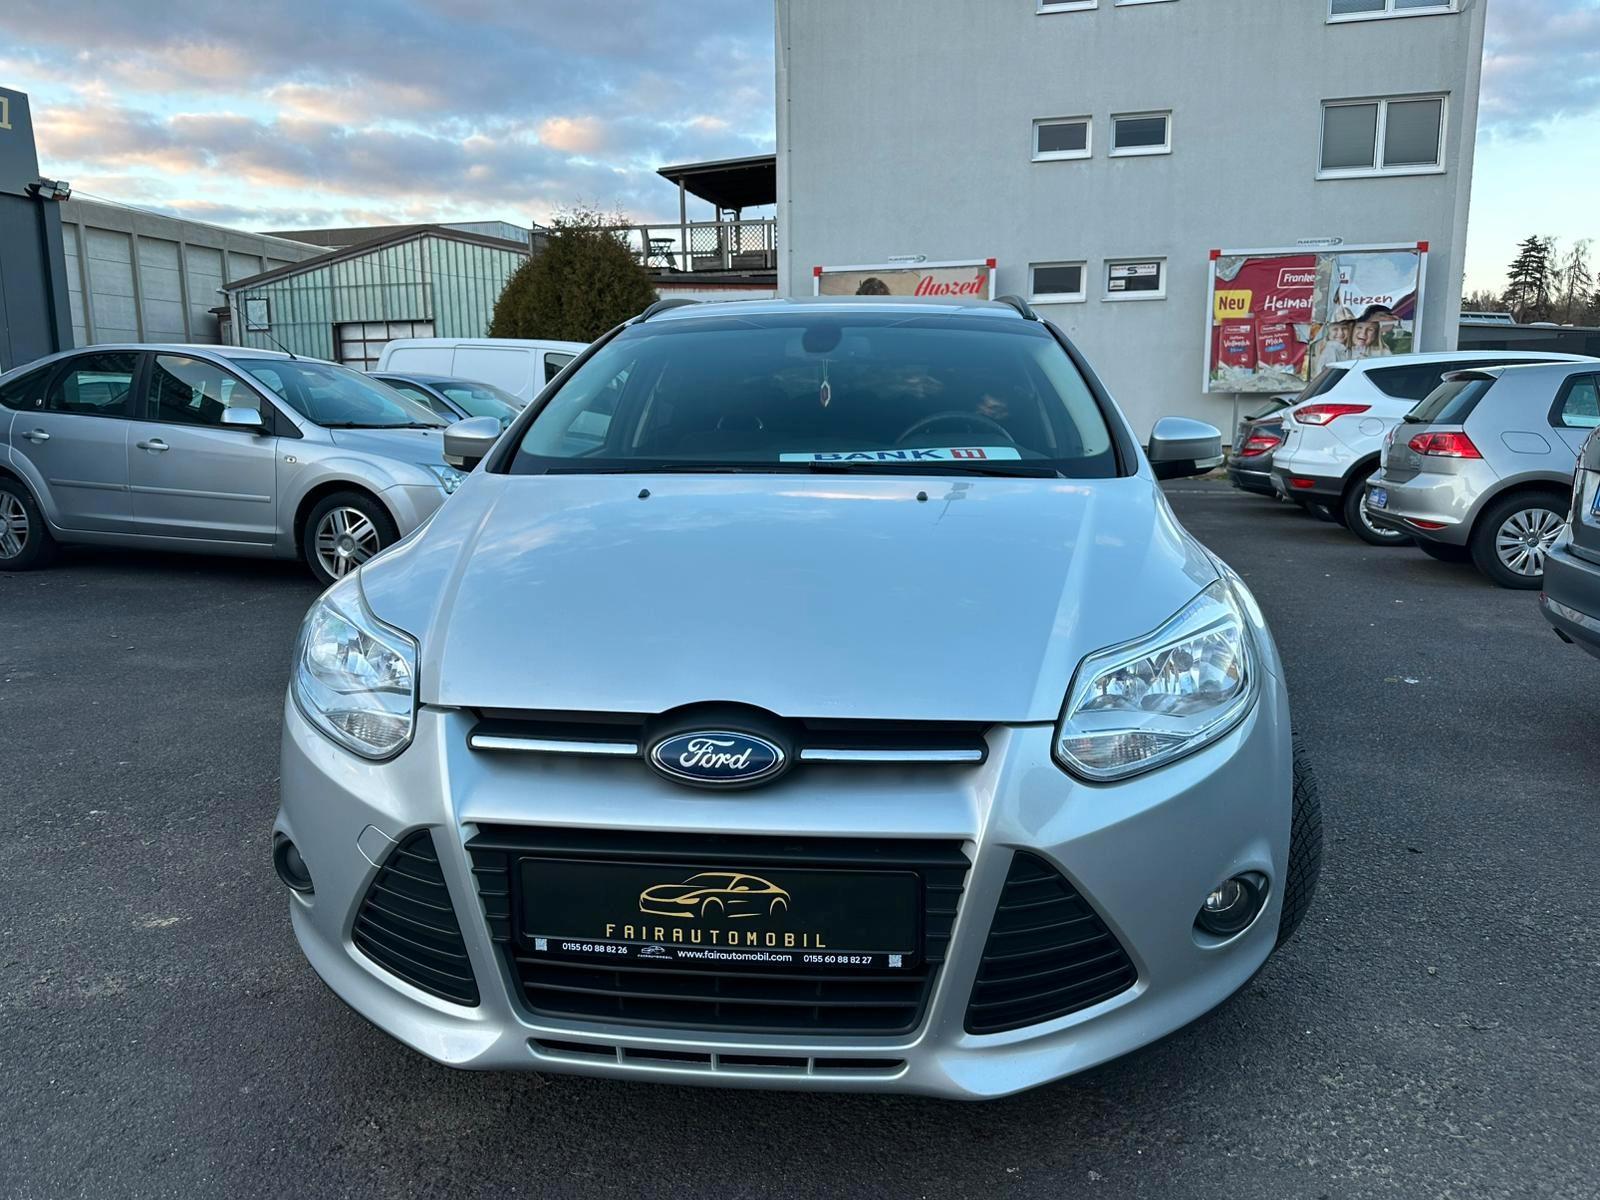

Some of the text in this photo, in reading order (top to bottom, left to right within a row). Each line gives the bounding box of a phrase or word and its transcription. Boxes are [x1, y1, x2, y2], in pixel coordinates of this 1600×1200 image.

[914, 273, 987, 297] Auszeit
[1218, 295, 1245, 311] Neu
[1343, 290, 1393, 307] Herzen
[814, 449, 944, 461] BANK
[680, 738, 753, 769] Ford
[605, 923, 826, 949] FAIRAUTOMOBIL
[562, 942, 628, 954] 0155 60 88 82 26
[677, 950, 793, 962] www.fairautomobil.com
[803, 954, 872, 964] 0155 60 88 82 27
